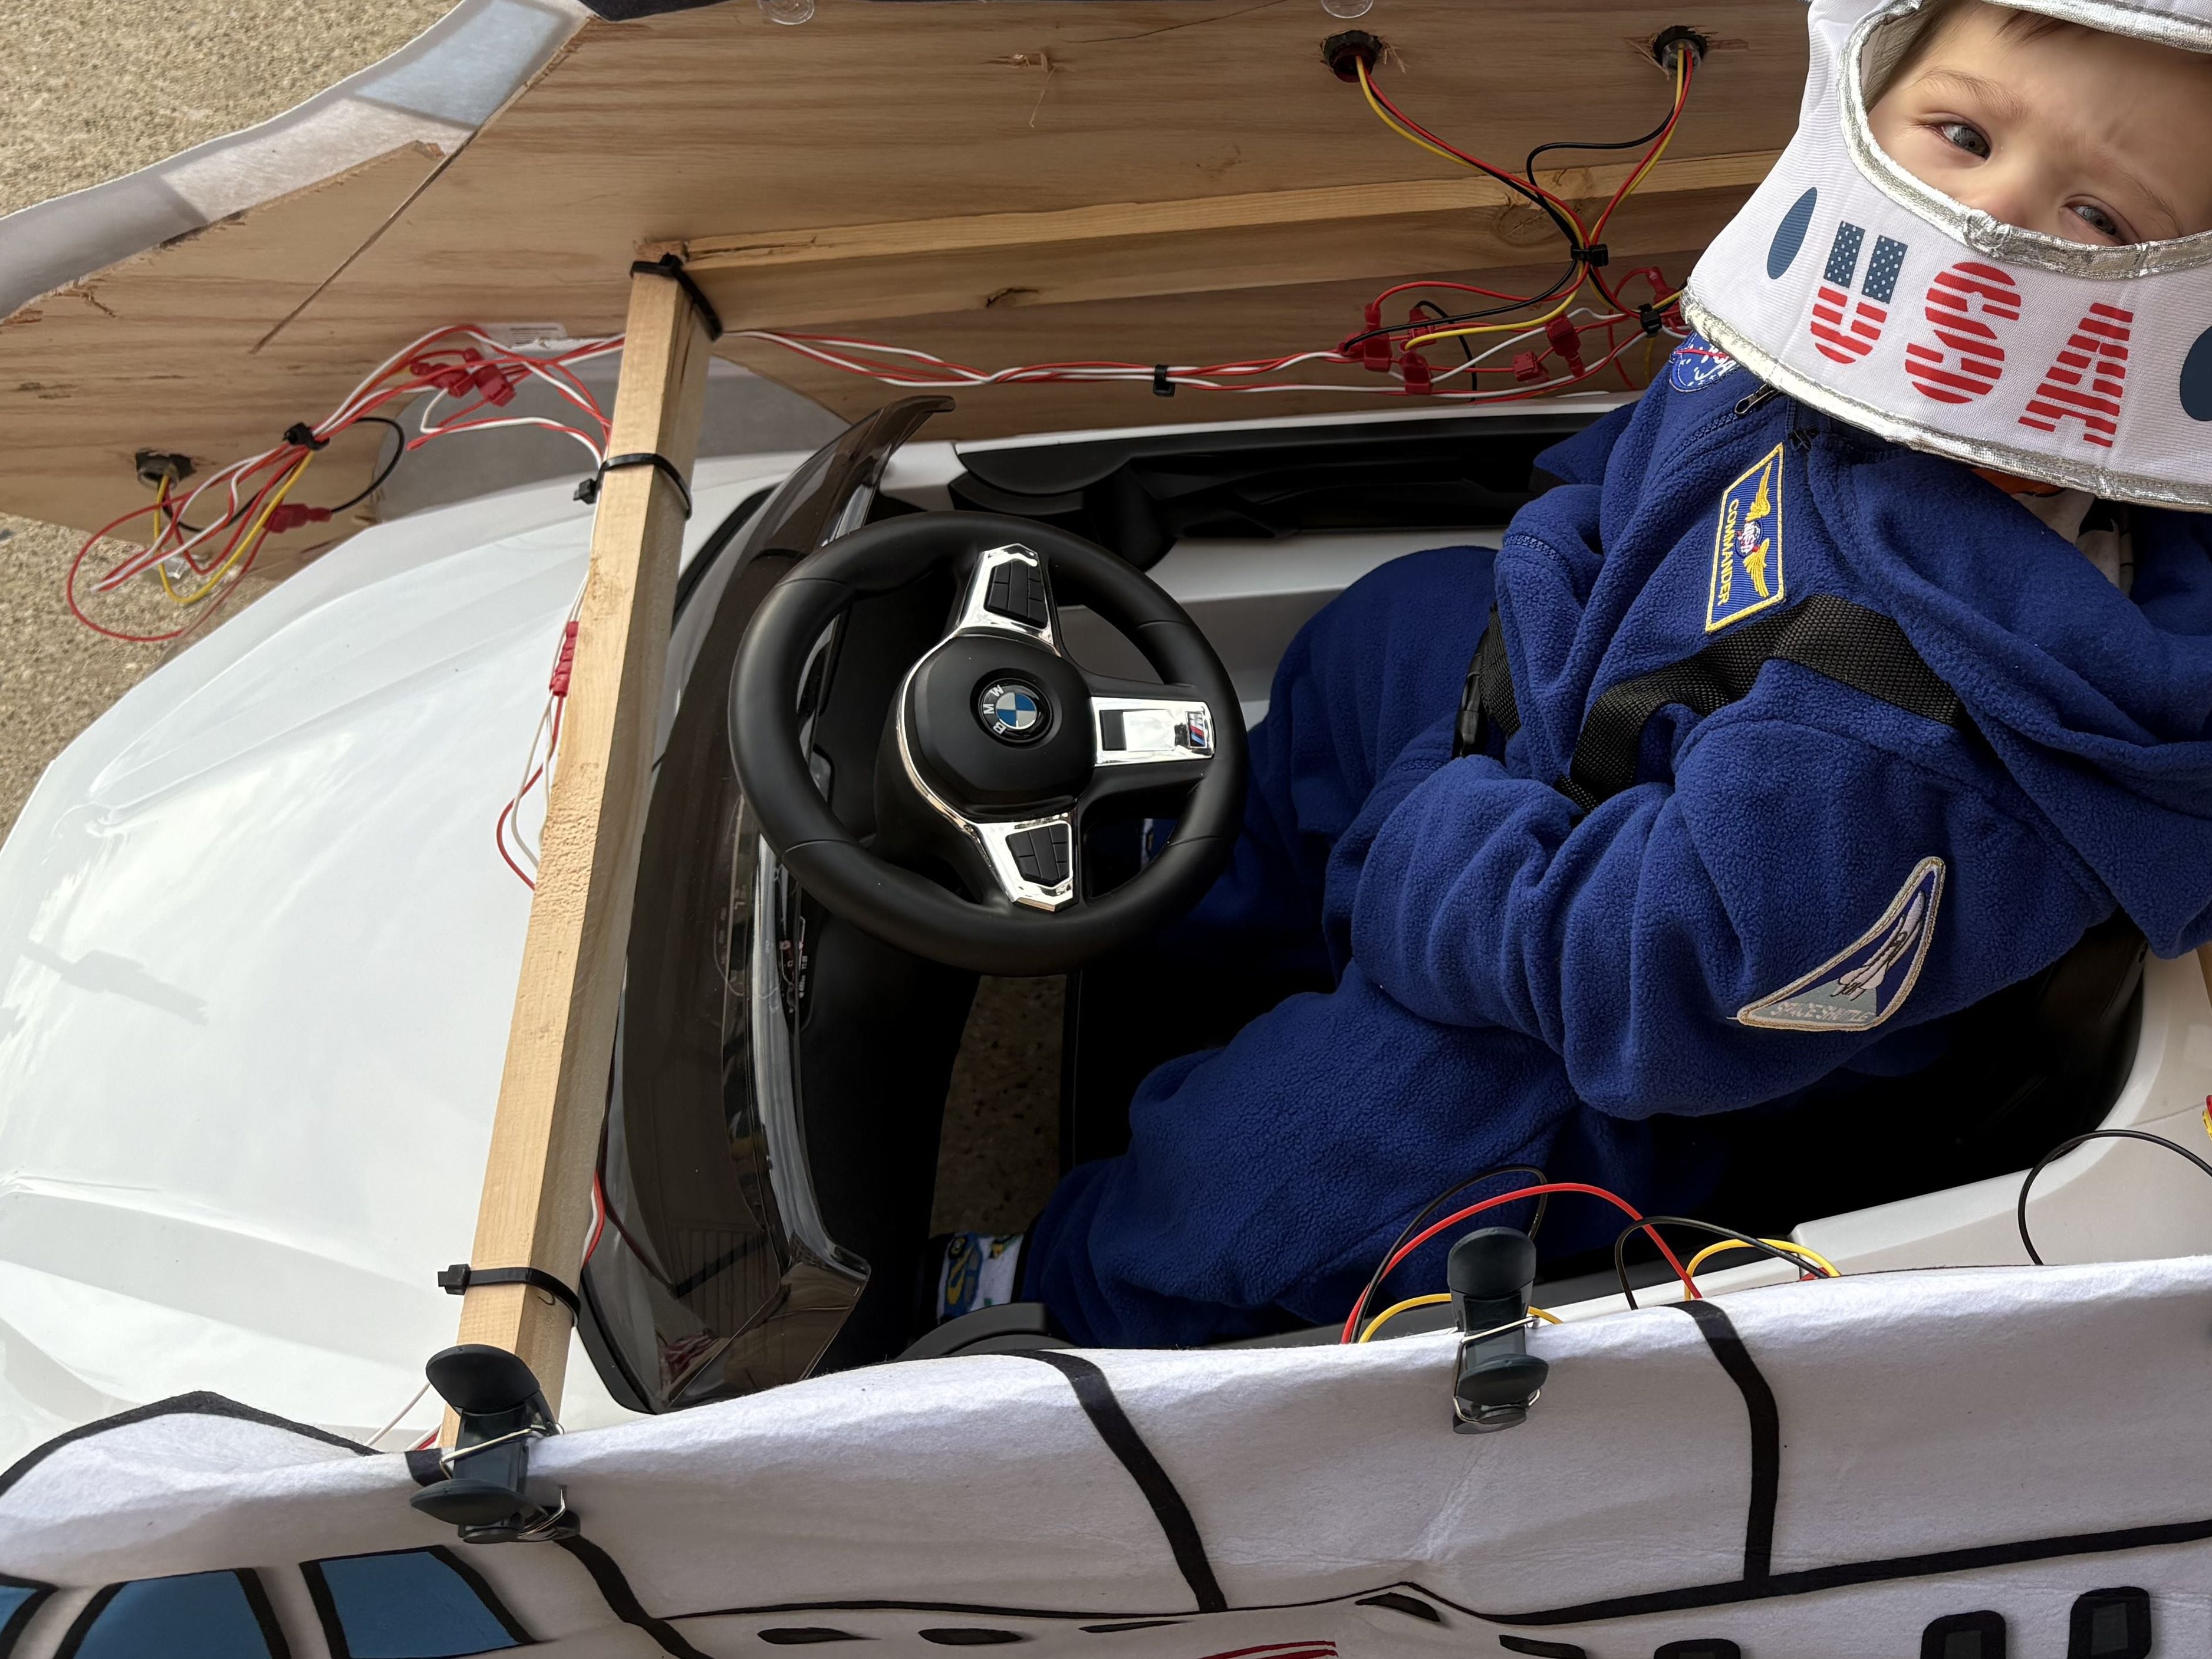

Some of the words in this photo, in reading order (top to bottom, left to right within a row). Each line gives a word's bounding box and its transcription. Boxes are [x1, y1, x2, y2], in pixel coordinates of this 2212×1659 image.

[1809, 220, 2134, 447] USA
[1717, 499, 1739, 605] COMMANDER
[983, 684, 1006, 735] BMW
[1770, 1001, 1823, 1018] SPACE
